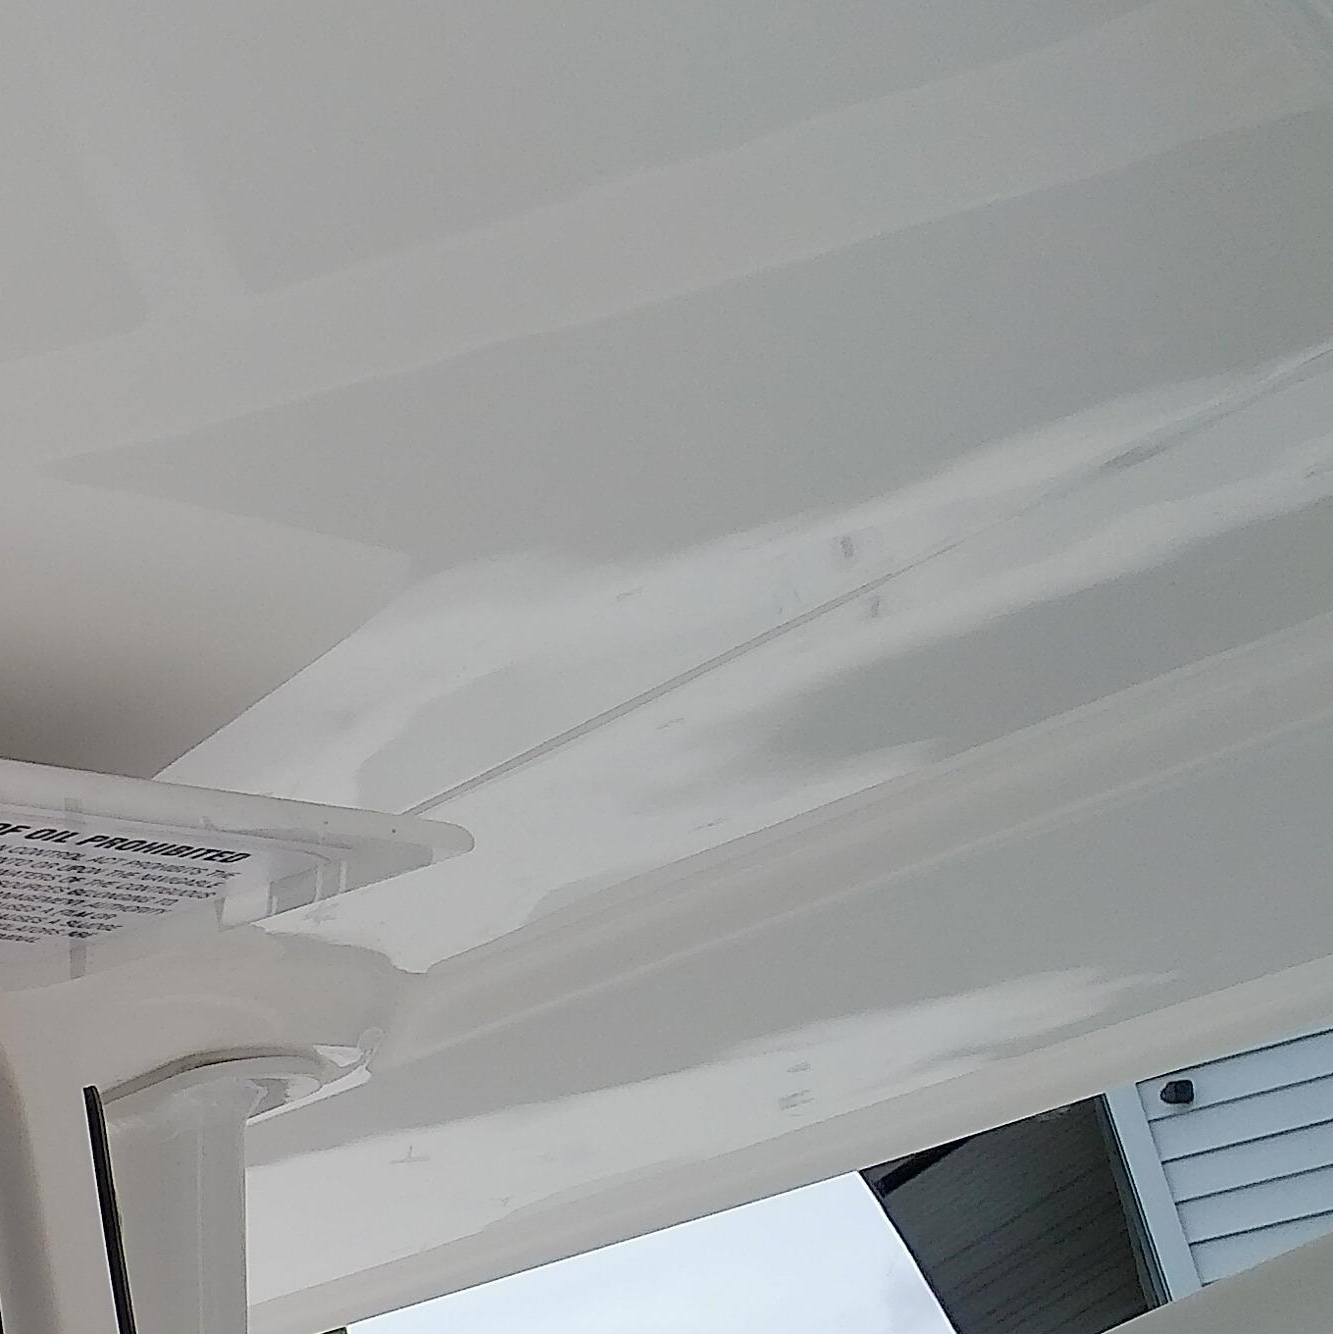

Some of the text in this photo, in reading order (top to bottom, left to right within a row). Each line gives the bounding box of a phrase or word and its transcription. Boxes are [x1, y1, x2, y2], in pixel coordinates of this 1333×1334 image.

[8, 846, 85, 860] CONTROL
[24, 828, 78, 842] OIL
[76, 835, 249, 862] PROHIBITED
